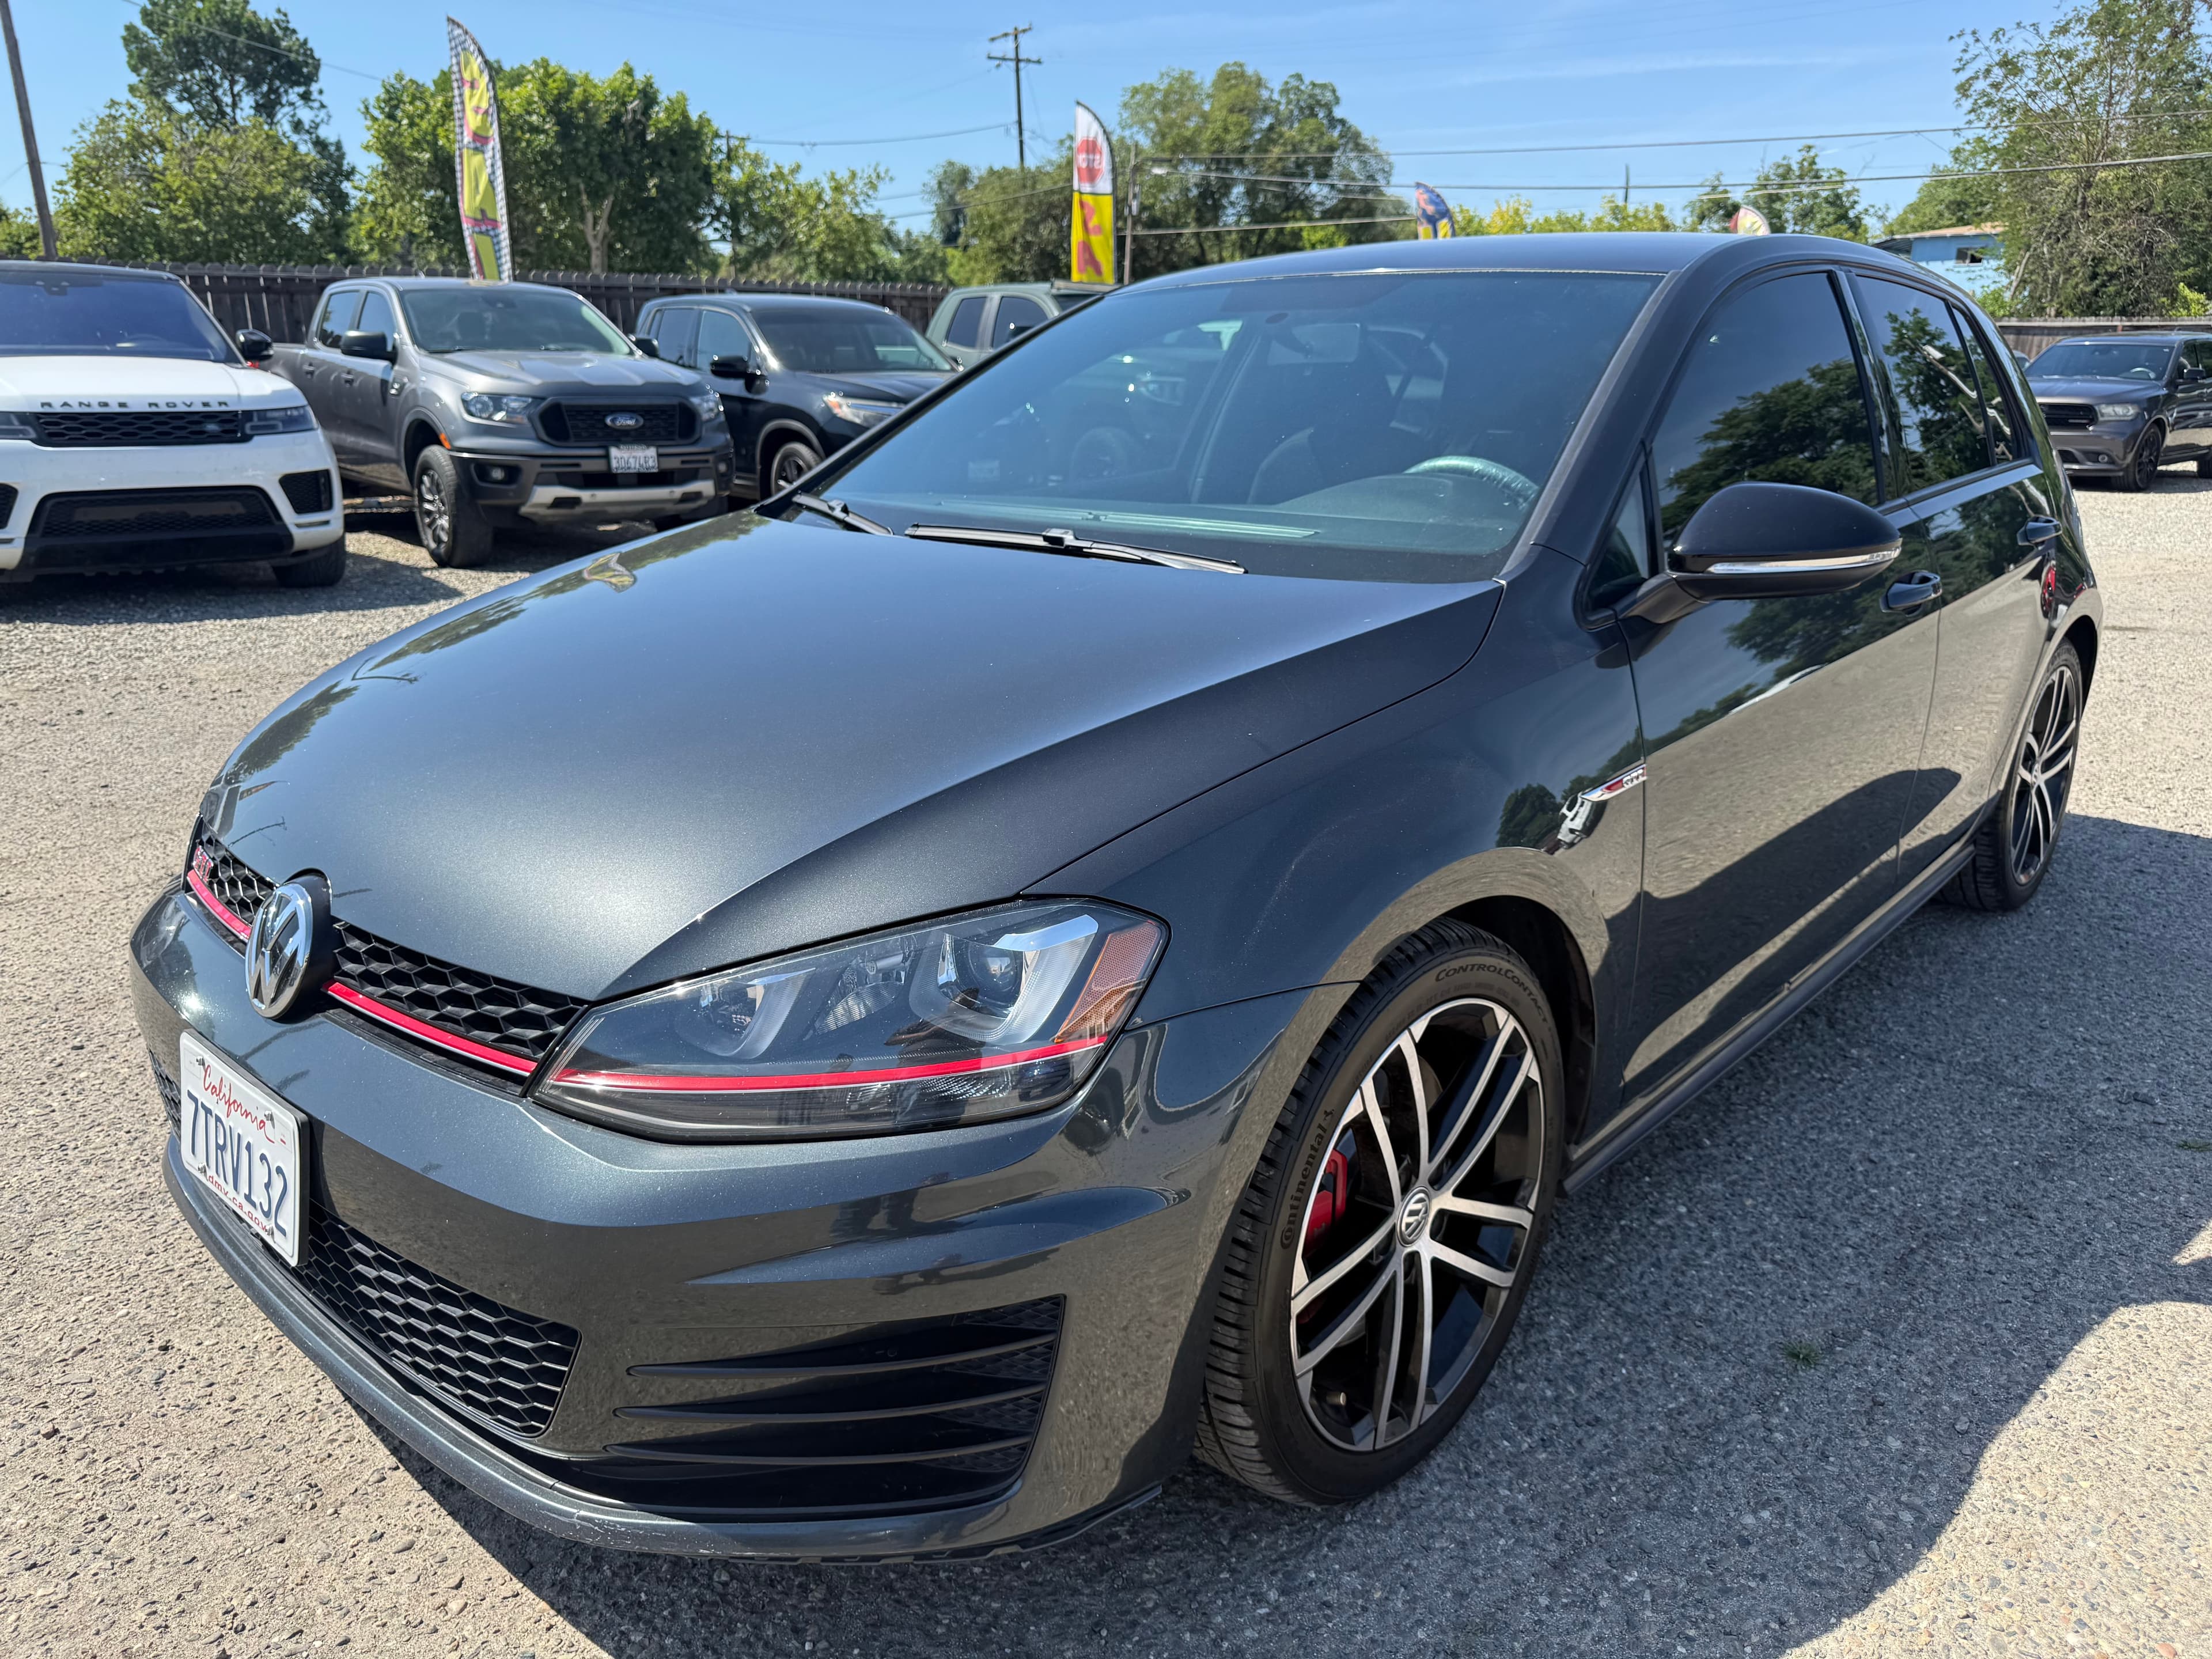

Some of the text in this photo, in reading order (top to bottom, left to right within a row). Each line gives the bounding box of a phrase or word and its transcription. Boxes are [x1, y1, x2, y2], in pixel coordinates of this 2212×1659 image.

[40, 400, 230, 409] RANGE ROVER
[203, 1065, 275, 1144] California
[187, 1089, 287, 1237] 7TRV132
[1280, 1123, 1327, 1249] Continental
[208, 1175, 267, 1232] dmv.ca.gov
